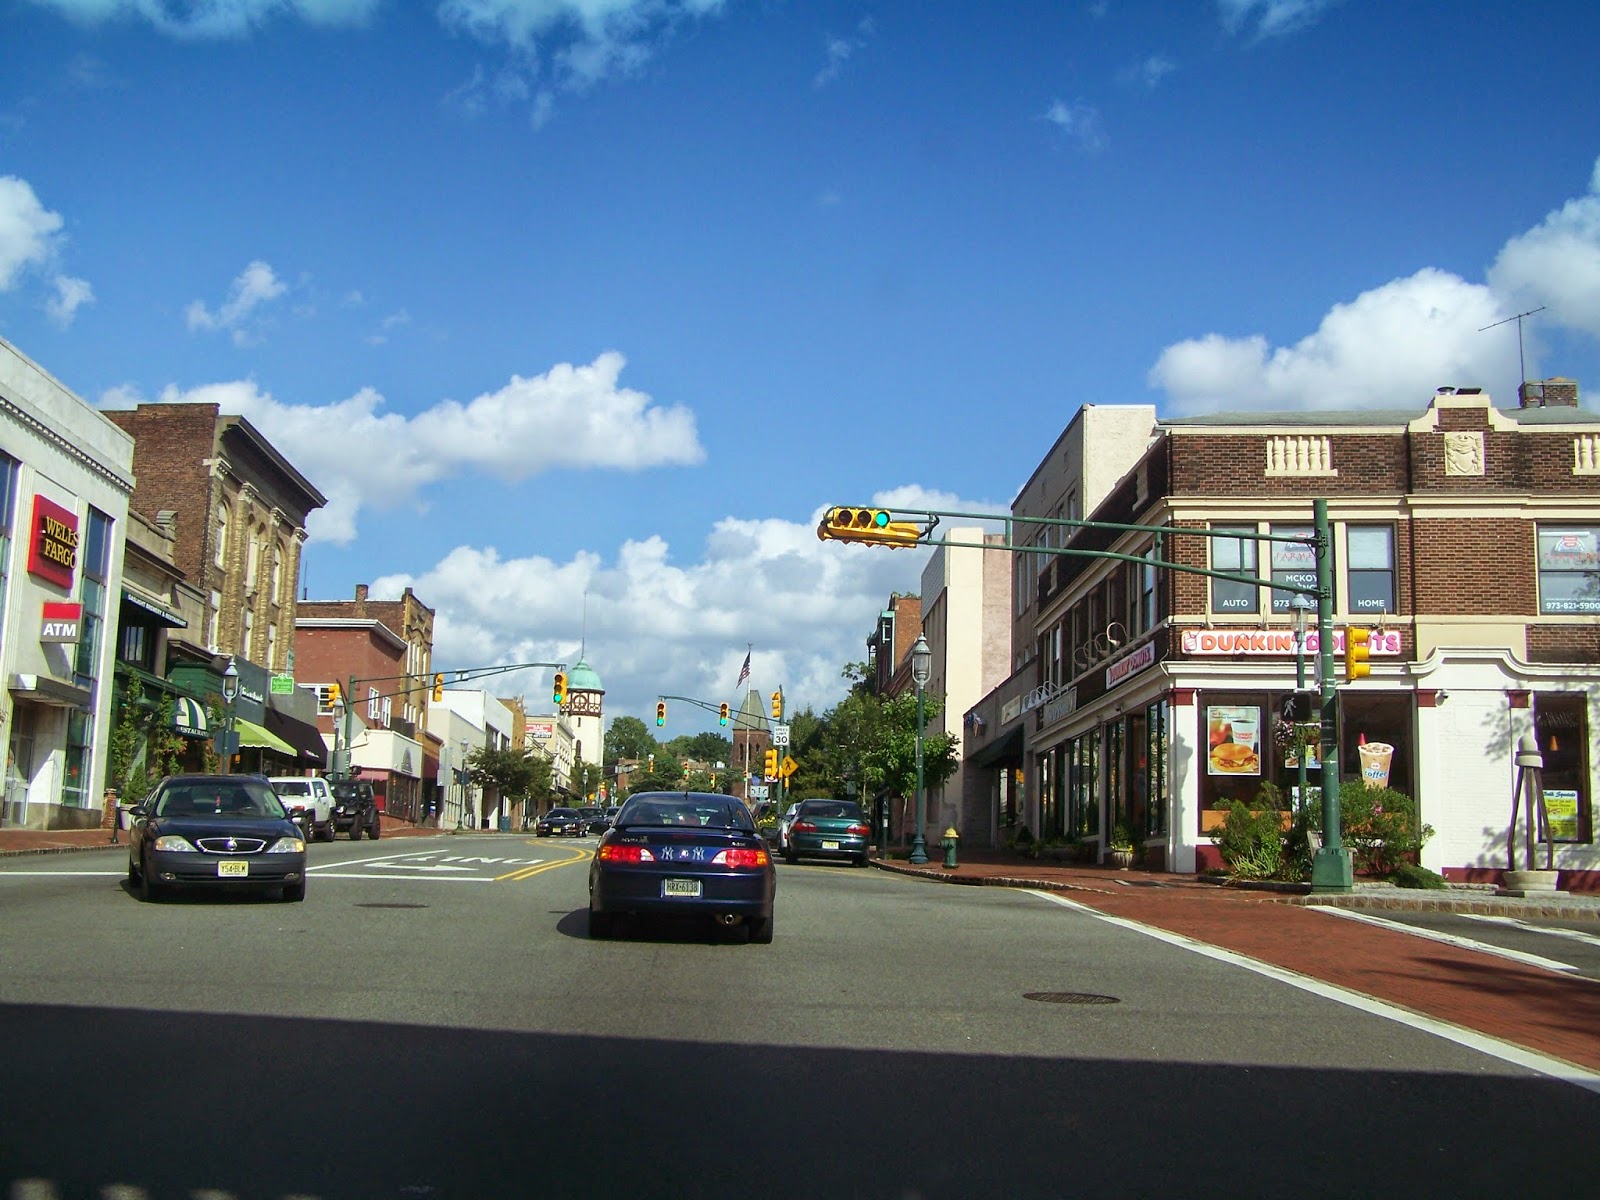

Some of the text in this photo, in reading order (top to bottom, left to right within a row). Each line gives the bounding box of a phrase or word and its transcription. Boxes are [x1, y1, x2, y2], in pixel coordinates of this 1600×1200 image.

[46, 516, 80, 549] WELLS
[44, 538, 77, 569] FARGO
[1223, 599, 1248, 607] AUTO
[1357, 599, 1384, 607] HOME
[1546, 602, 1600, 610] 973-821-5900
[43, 623, 77, 636] ATM
[775, 735, 788, 743] 30
